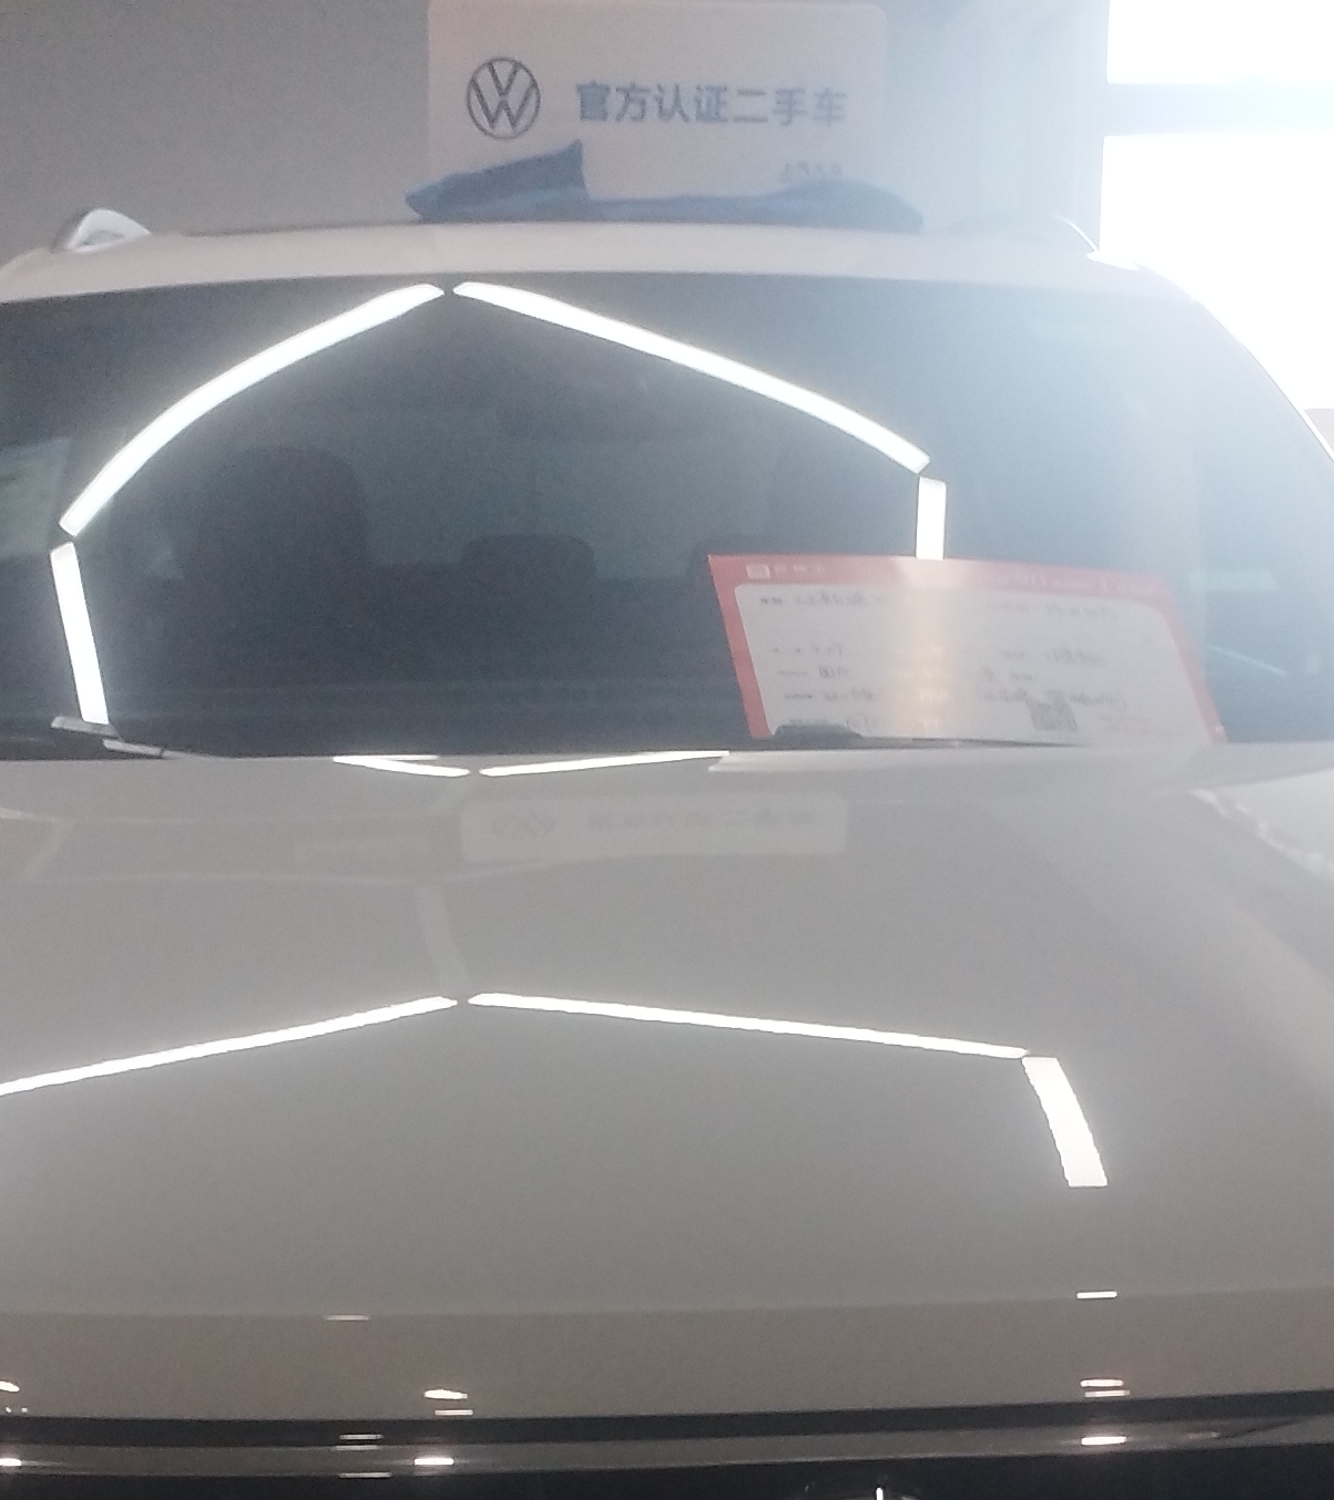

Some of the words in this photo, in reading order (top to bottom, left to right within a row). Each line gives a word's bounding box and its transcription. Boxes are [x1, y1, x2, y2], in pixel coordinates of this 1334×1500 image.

[575, 80, 848, 127] 官方认证二手车
